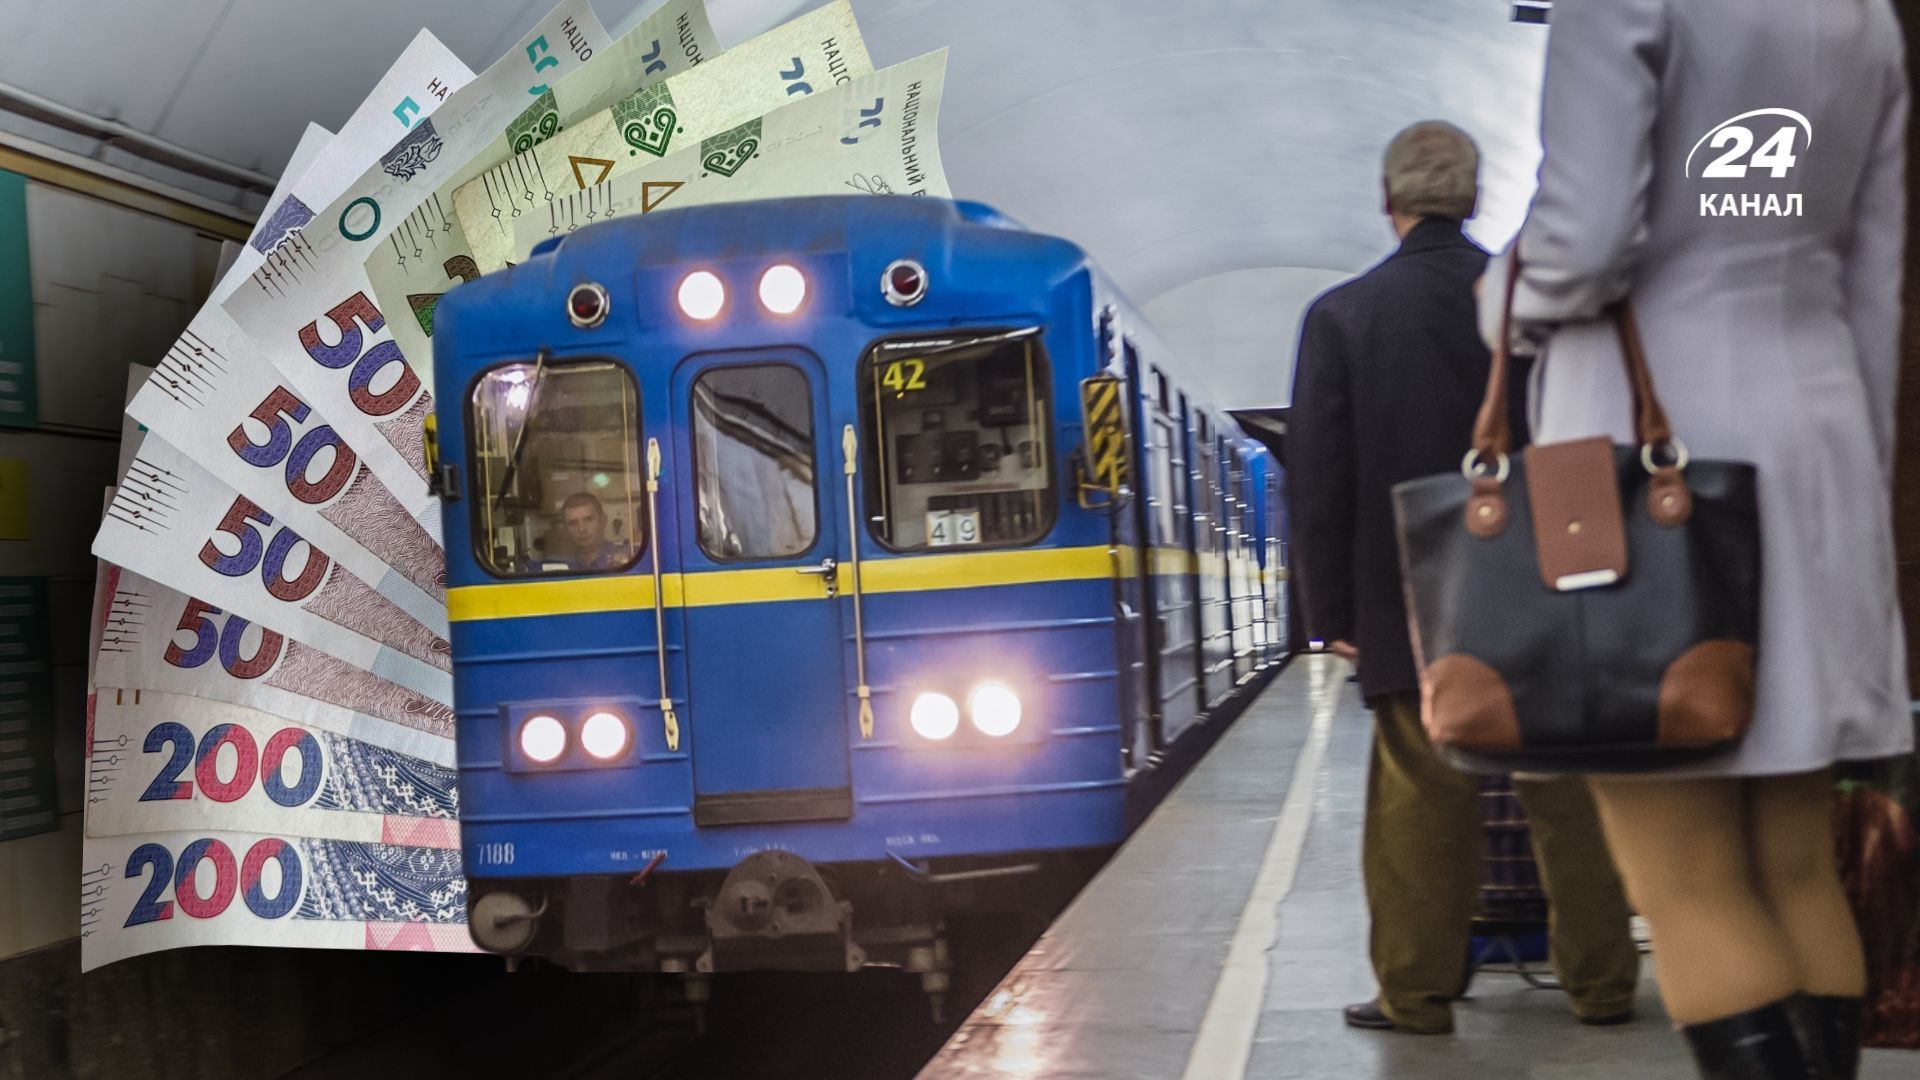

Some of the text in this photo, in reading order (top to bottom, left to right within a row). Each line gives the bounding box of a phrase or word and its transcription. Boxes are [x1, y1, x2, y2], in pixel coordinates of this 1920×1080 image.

[426, 76, 454, 102] НА
[901, 80, 927, 187] НАЦІОНАЛЬНИЙ
[298, 291, 422, 416] 50
[881, 358, 927, 391] 42
[227, 384, 357, 505] 50
[198, 493, 331, 603] 50
[164, 597, 285, 680] 50
[138, 721, 324, 808] 200
[123, 837, 303, 929] 200
[476, 842, 515, 865] 7188
